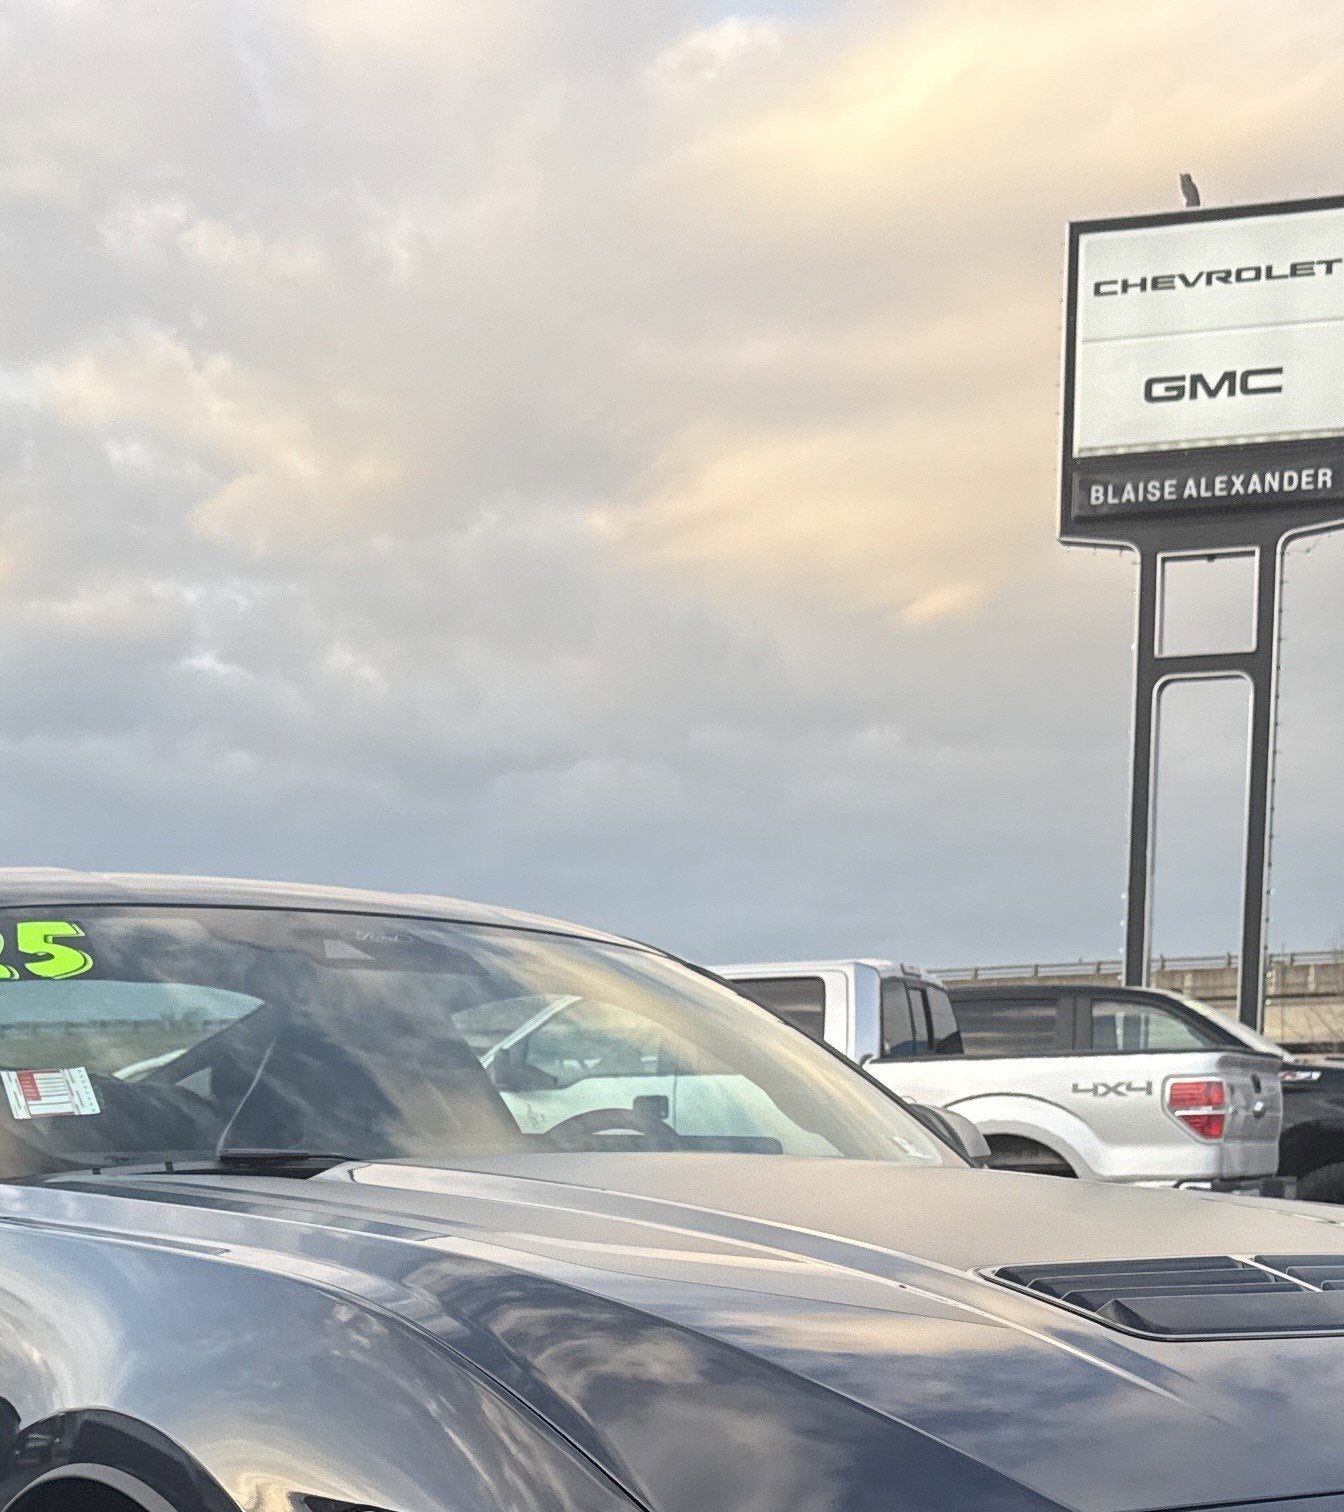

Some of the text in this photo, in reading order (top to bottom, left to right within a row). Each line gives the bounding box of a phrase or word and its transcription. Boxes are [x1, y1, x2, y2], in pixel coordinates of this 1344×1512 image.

[1093, 258, 1343, 297] CHEVROLET
[1143, 366, 1284, 404] GMC
[1090, 467, 1334, 506] BLAISE ALEXANDER
